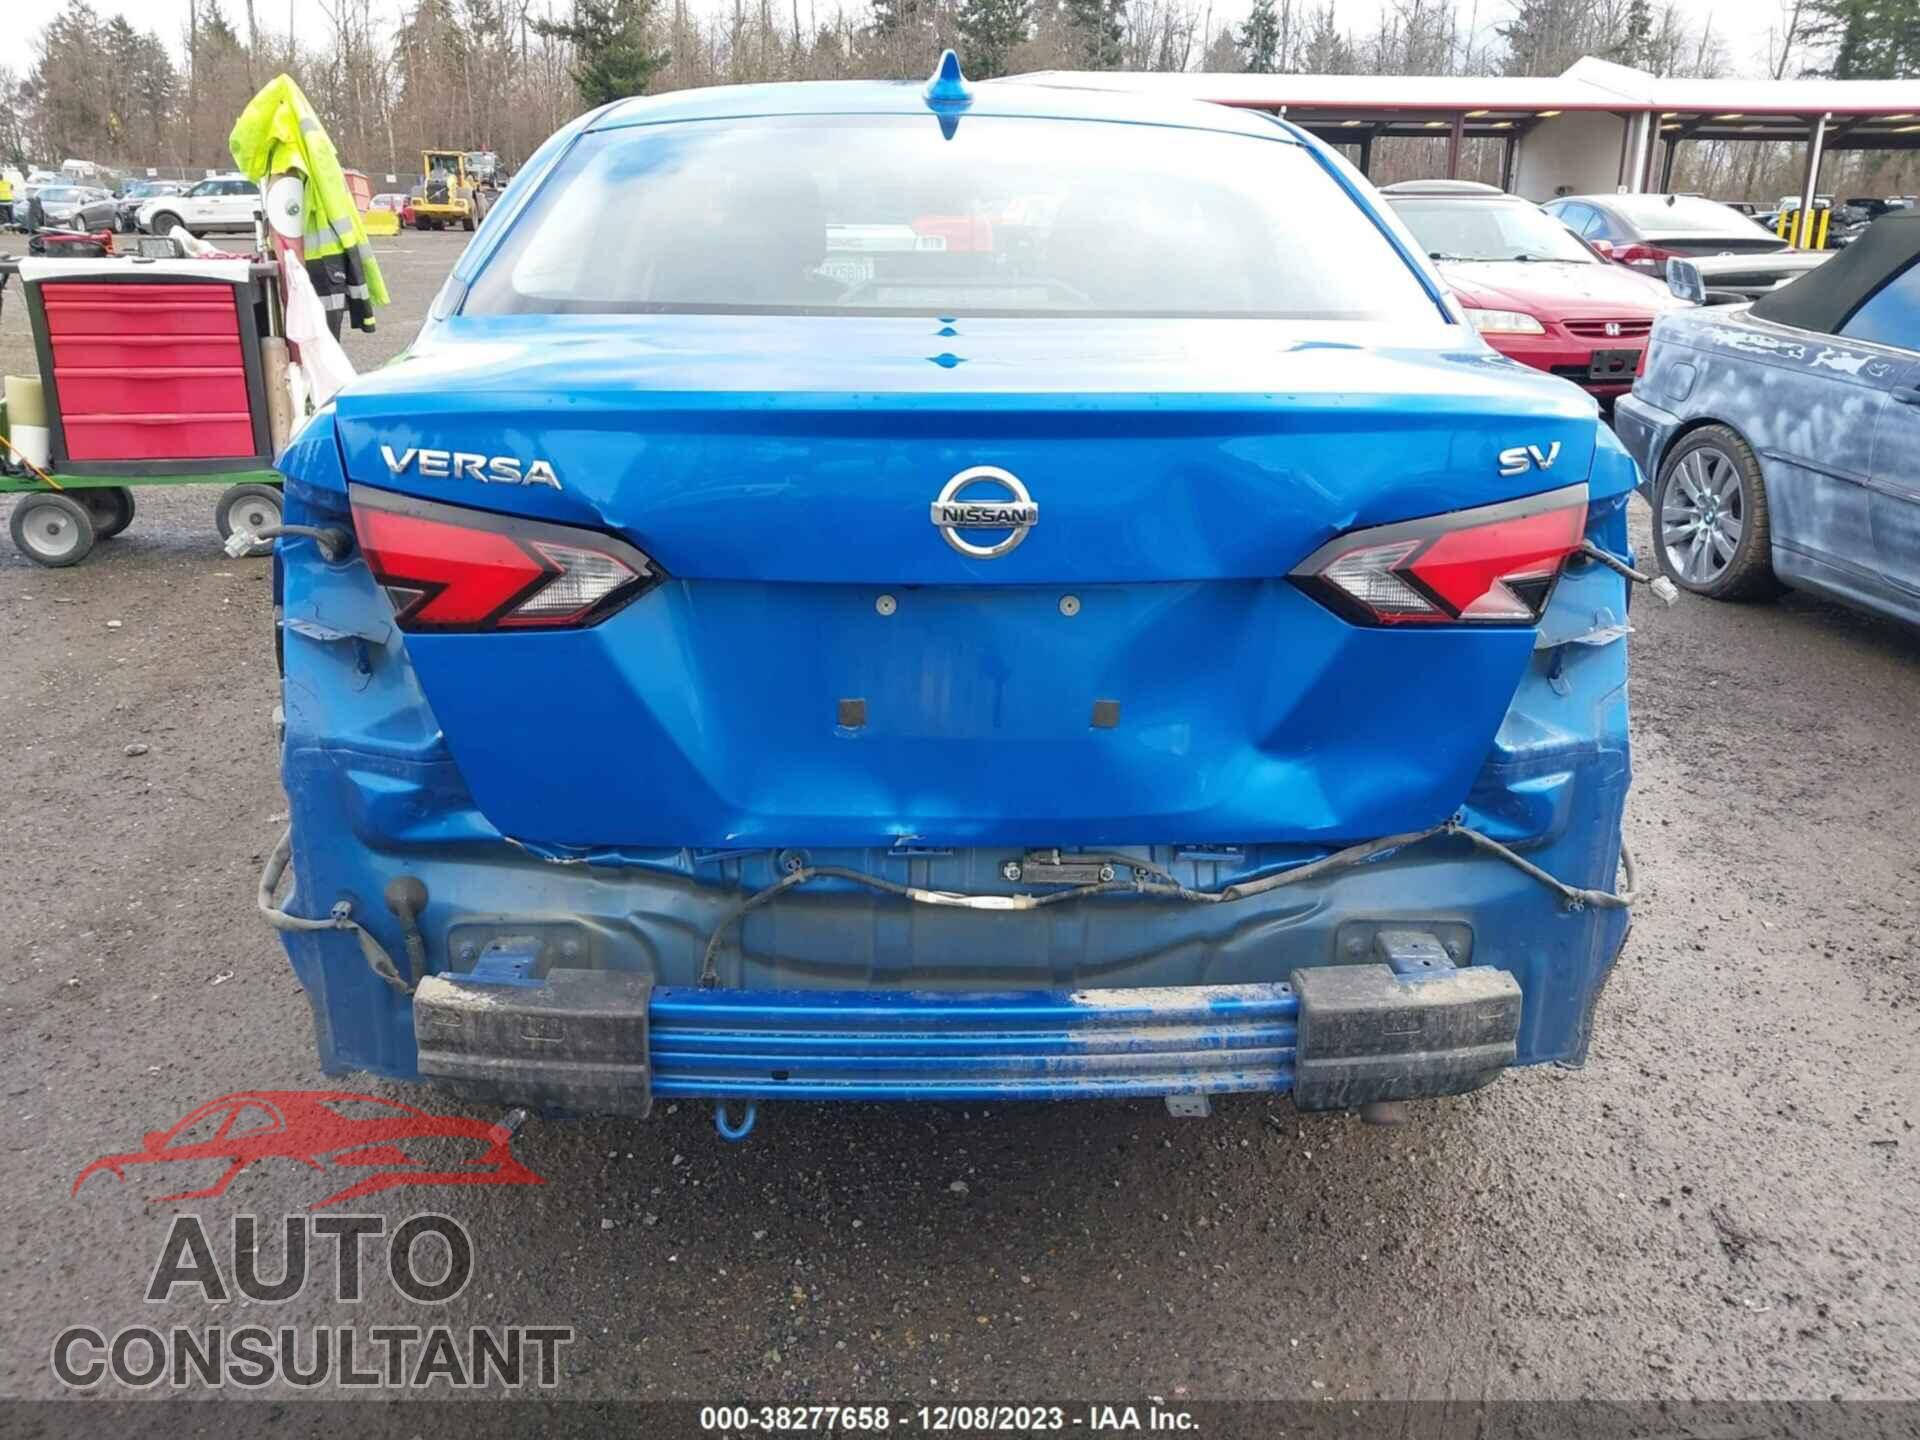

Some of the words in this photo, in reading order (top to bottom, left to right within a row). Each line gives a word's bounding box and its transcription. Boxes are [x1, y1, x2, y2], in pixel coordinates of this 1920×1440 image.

[380, 445, 563, 491] VERSA
[1498, 441, 1561, 477] SV
[942, 507, 1028, 522] NISSAN
